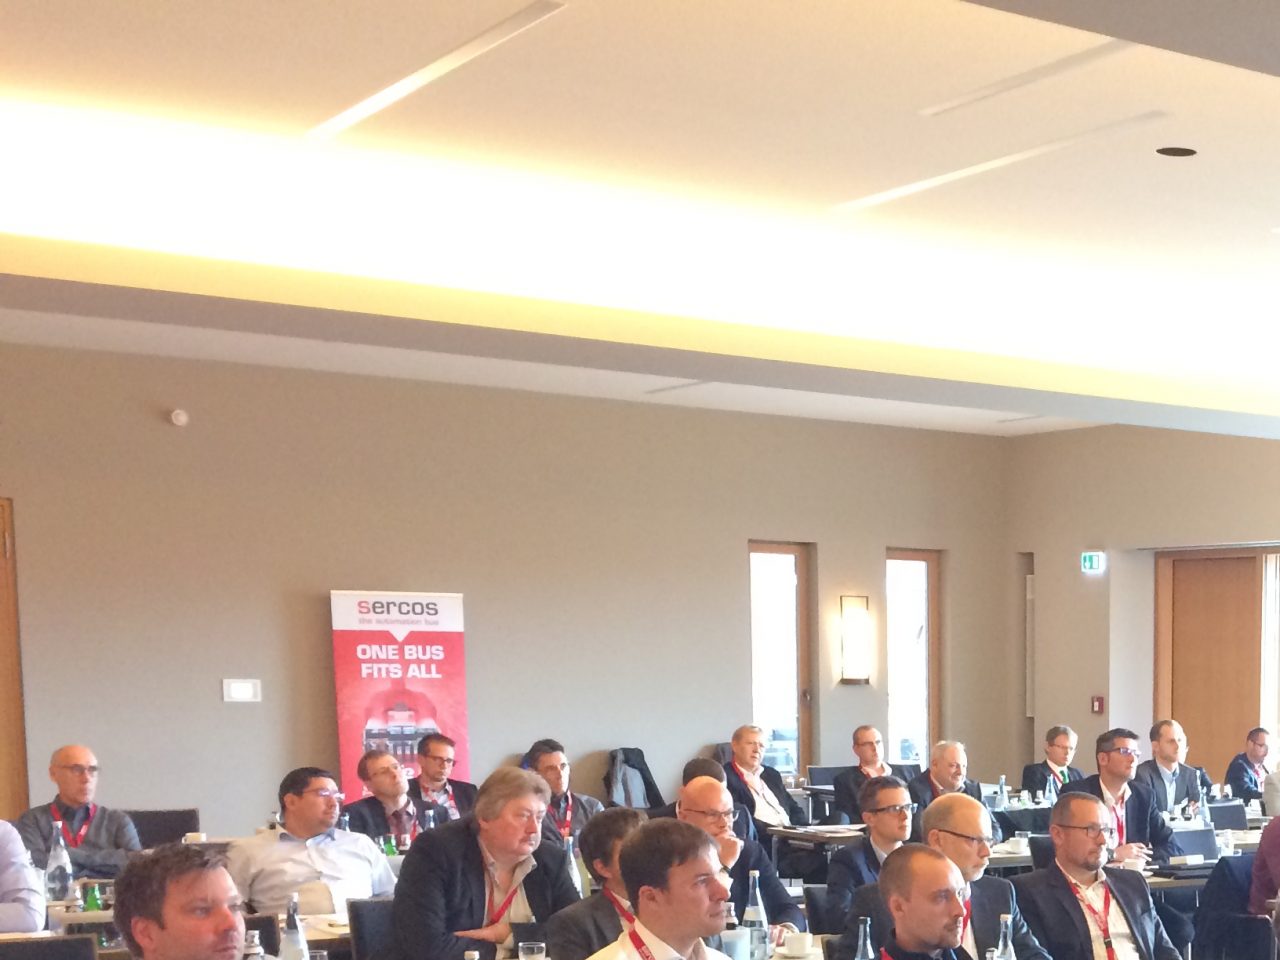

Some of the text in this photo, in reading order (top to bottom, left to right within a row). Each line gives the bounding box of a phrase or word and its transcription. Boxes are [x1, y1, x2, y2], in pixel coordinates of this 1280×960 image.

[357, 600, 439, 616] sercos
[356, 644, 445, 660] ONE BUS
[361, 663, 442, 678] FITS ALL
